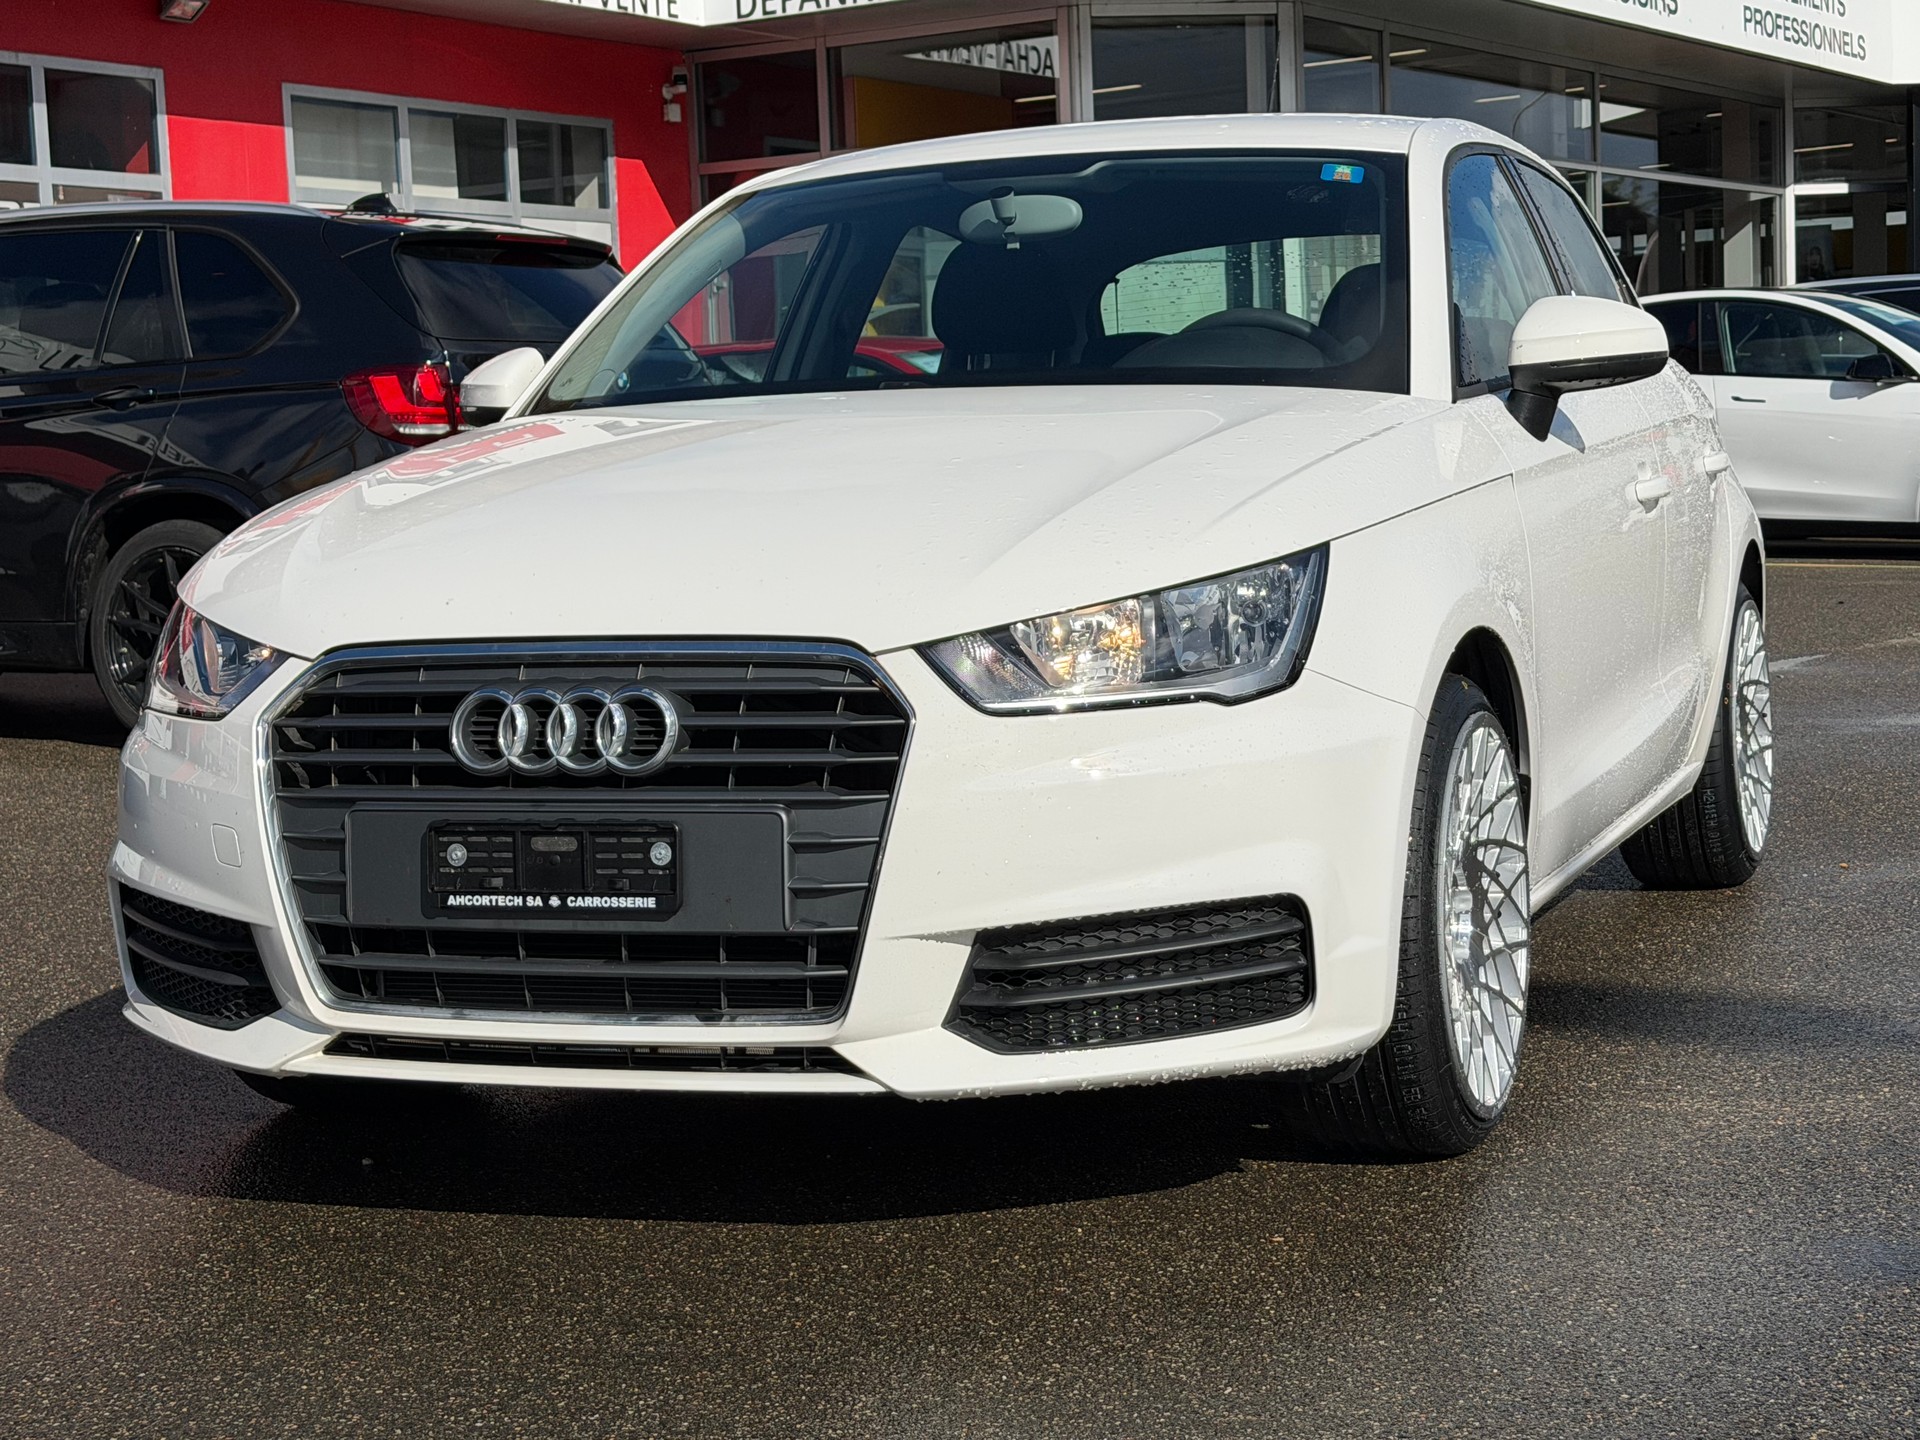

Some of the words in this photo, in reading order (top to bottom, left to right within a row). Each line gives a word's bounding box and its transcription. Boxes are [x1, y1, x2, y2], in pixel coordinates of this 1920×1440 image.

[1743, 5, 1866, 61] PROFESSIONNELS
[447, 894, 523, 906] AHCORTECH
[526, 895, 543, 906] SA
[567, 896, 656, 908] CARROSSERIE
